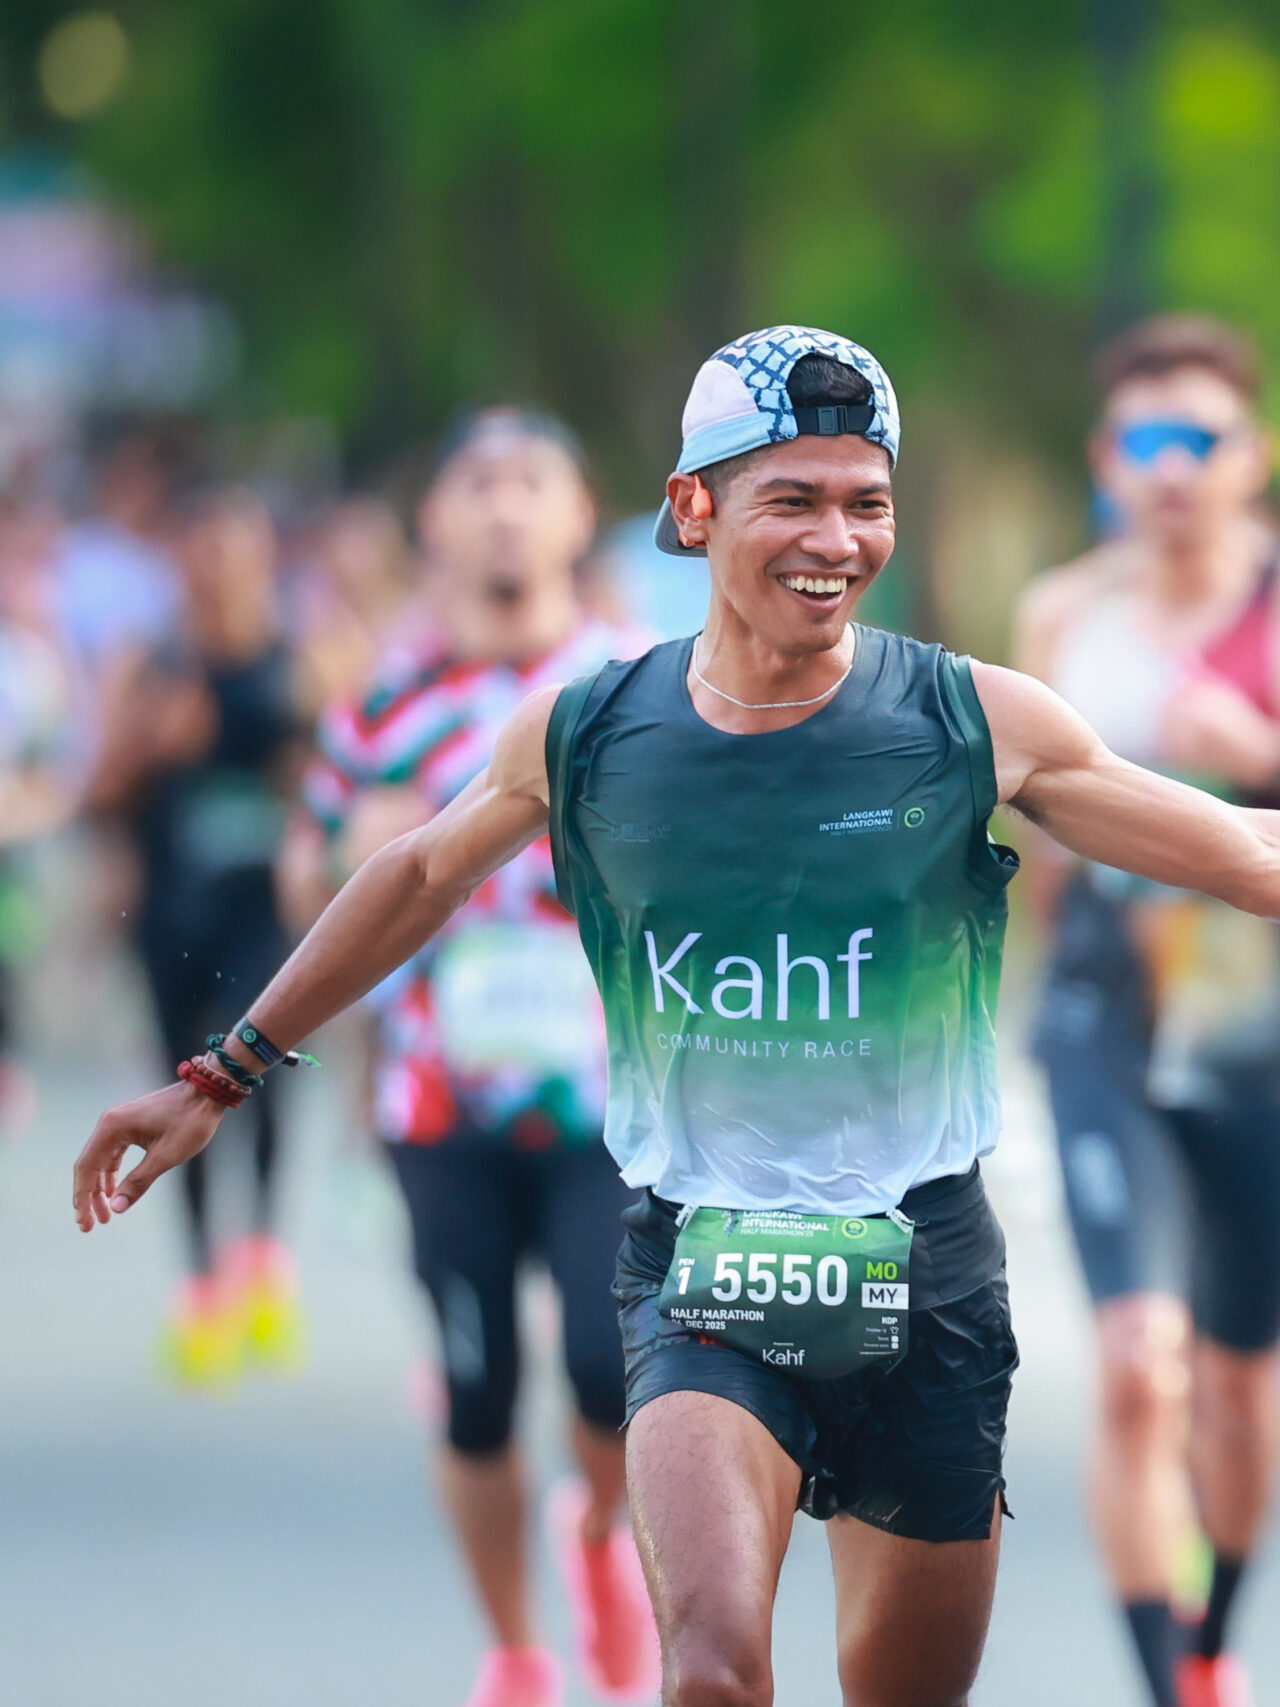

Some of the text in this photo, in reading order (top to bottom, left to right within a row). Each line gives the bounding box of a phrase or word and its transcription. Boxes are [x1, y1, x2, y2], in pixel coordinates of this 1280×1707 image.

[843, 808, 893, 821] LANGKAWI
[819, 817, 892, 832] INTERNATIONAL
[643, 927, 873, 1022] Kahf
[656, 1032, 872, 1059] COMMUNITY RACE
[742, 1218, 829, 1231] INTERNATIONAL
[678, 1257, 696, 1267] PEN
[677, 1252, 898, 1307] 1 5550 MO
[868, 1287, 899, 1304] MY
[670, 1307, 765, 1321] HALF MARATHON
[685, 1320, 703, 1329] DEC
[704, 1320, 726, 1330] 2025
[762, 1348, 806, 1366] Kahf
